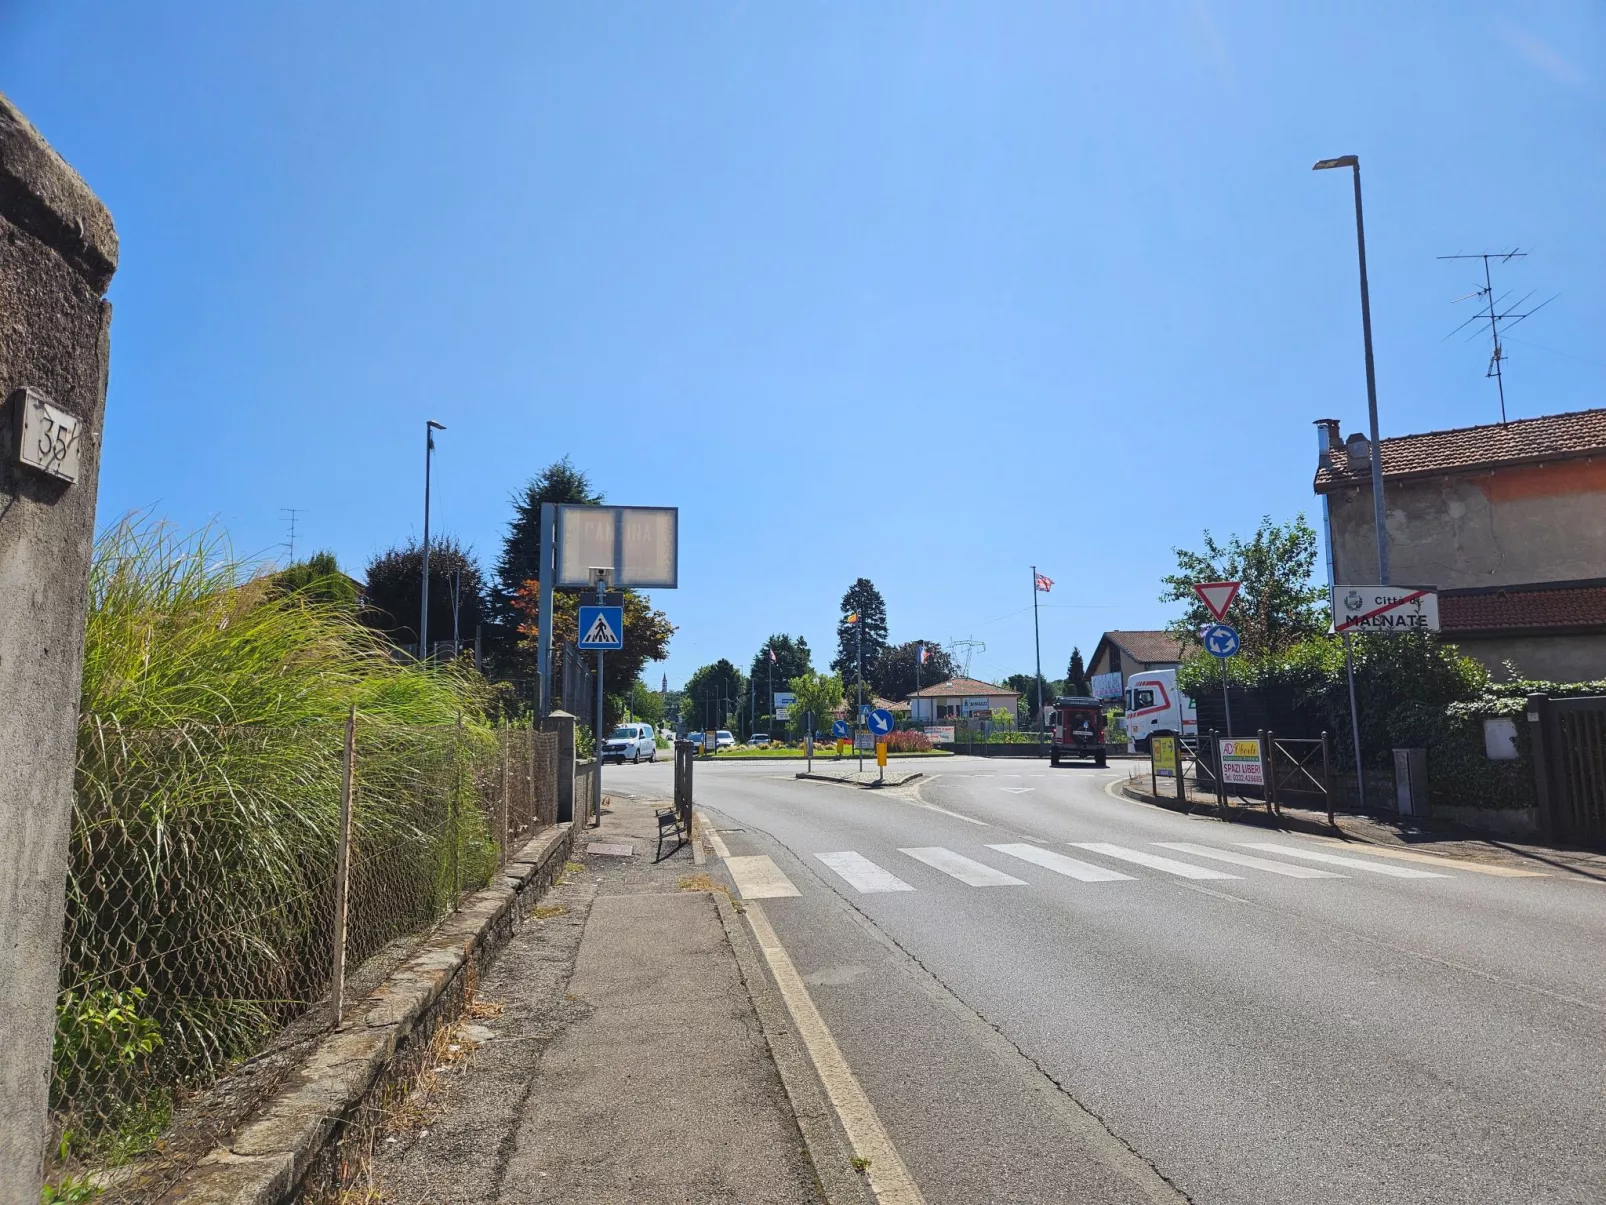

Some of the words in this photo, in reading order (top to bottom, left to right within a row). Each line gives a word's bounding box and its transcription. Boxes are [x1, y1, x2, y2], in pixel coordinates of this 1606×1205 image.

[38, 416, 68, 461] 35
[585, 520, 652, 542] CANINA
[1345, 614, 1428, 628] MALNATE
[1223, 763, 1241, 773] SPAZI
[1241, 764, 1261, 774] LIBERI
